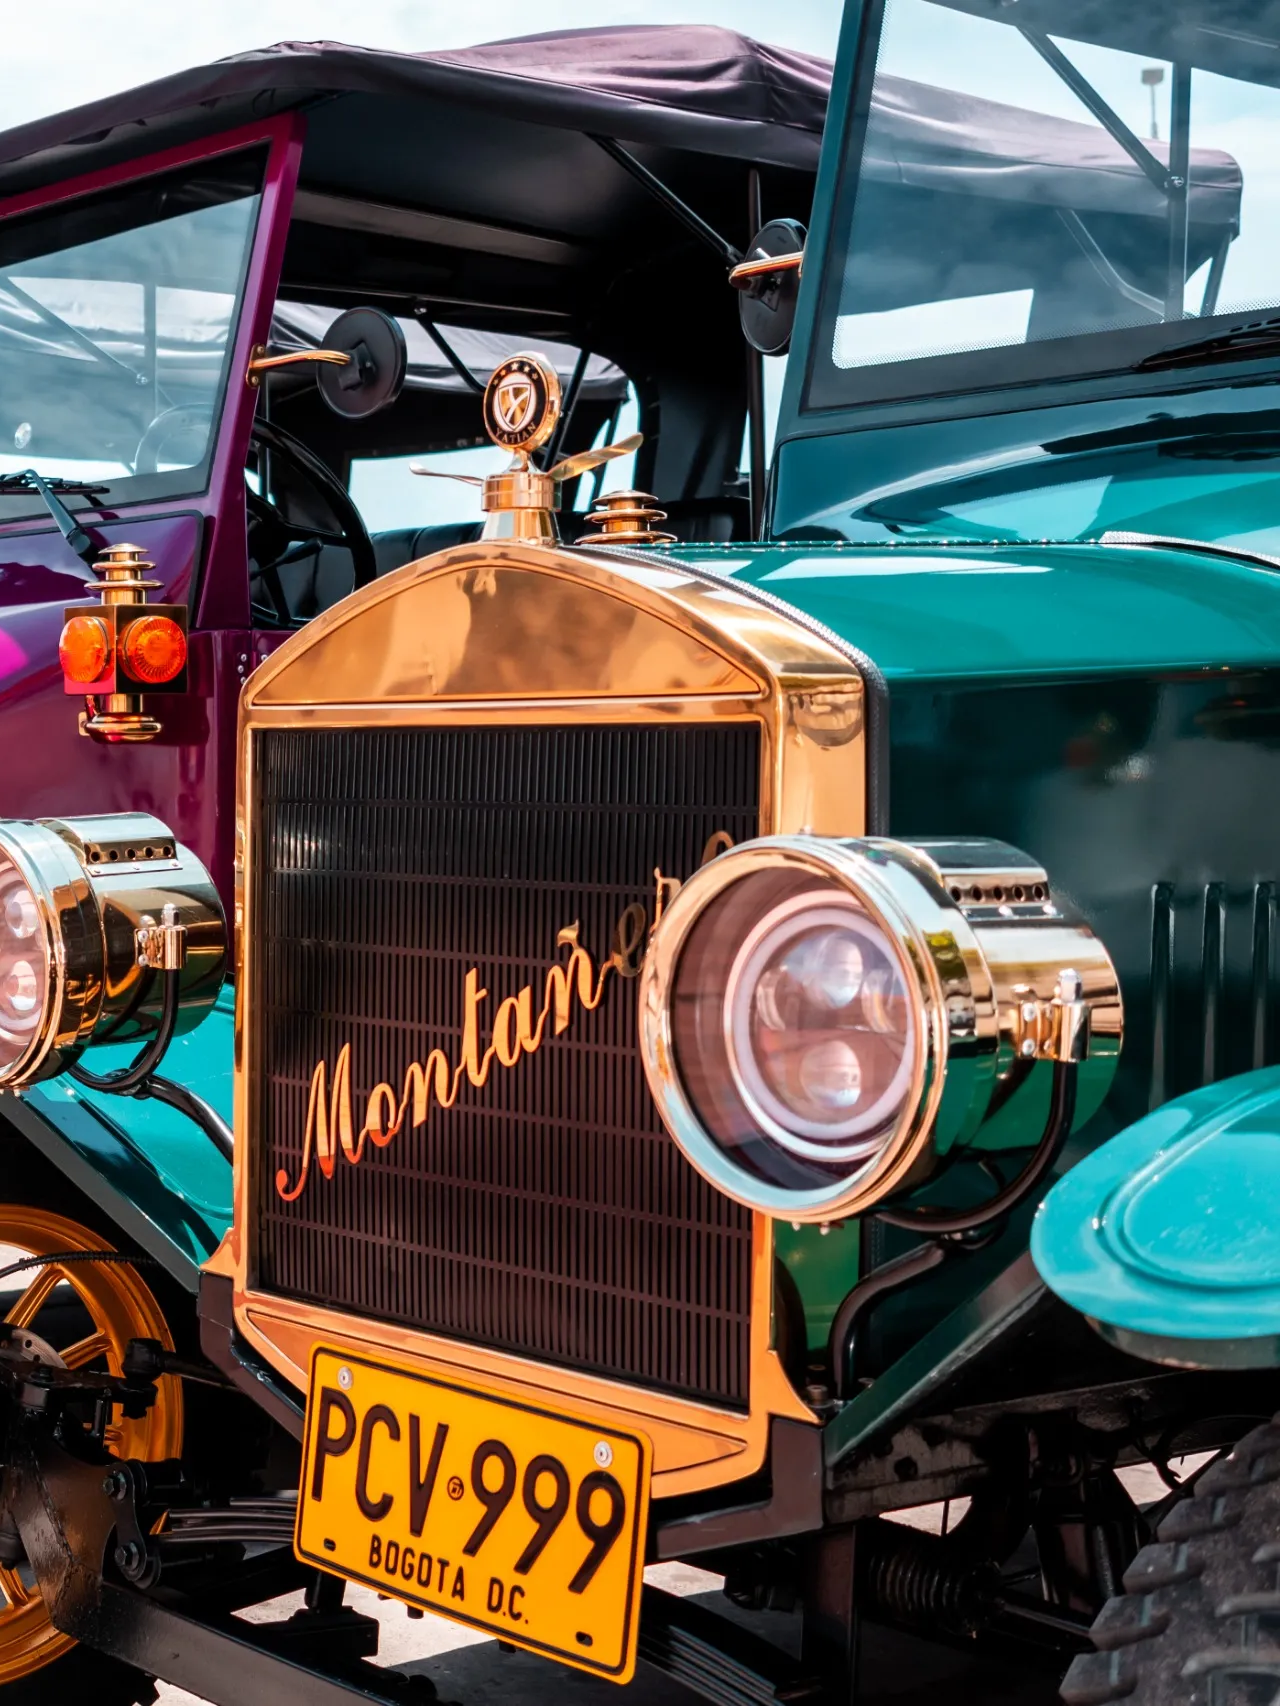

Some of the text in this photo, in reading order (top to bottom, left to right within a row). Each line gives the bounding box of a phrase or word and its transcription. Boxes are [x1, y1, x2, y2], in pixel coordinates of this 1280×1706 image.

[495, 422, 537, 443] YATIAN
[369, 1533, 530, 1625] BOGOTA D.C.
